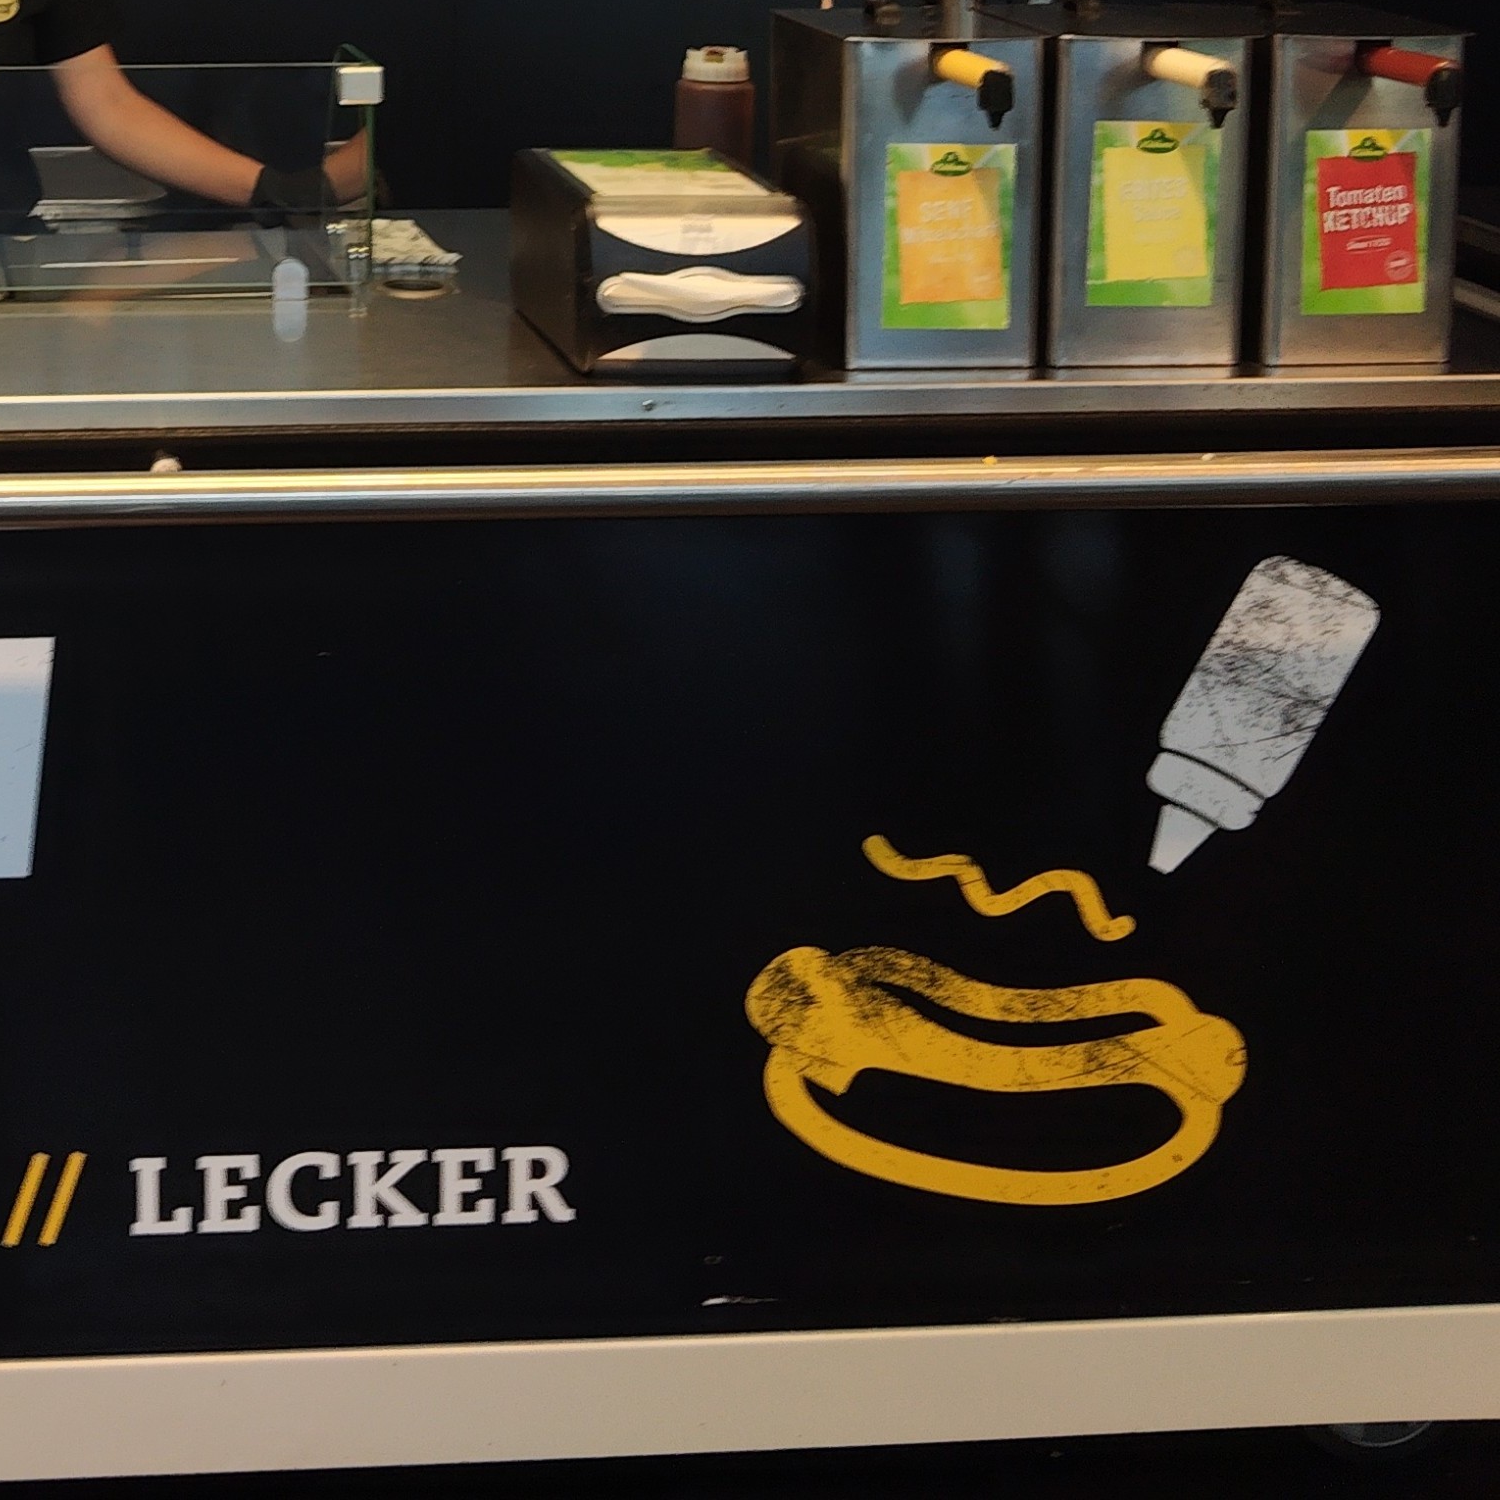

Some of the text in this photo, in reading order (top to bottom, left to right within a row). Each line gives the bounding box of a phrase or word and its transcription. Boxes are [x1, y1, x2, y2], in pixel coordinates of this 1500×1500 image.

[1326, 184, 1408, 208] Tomaten
[1323, 202, 1413, 234] KETCHUP
[127, 1144, 578, 1238] LECKER
